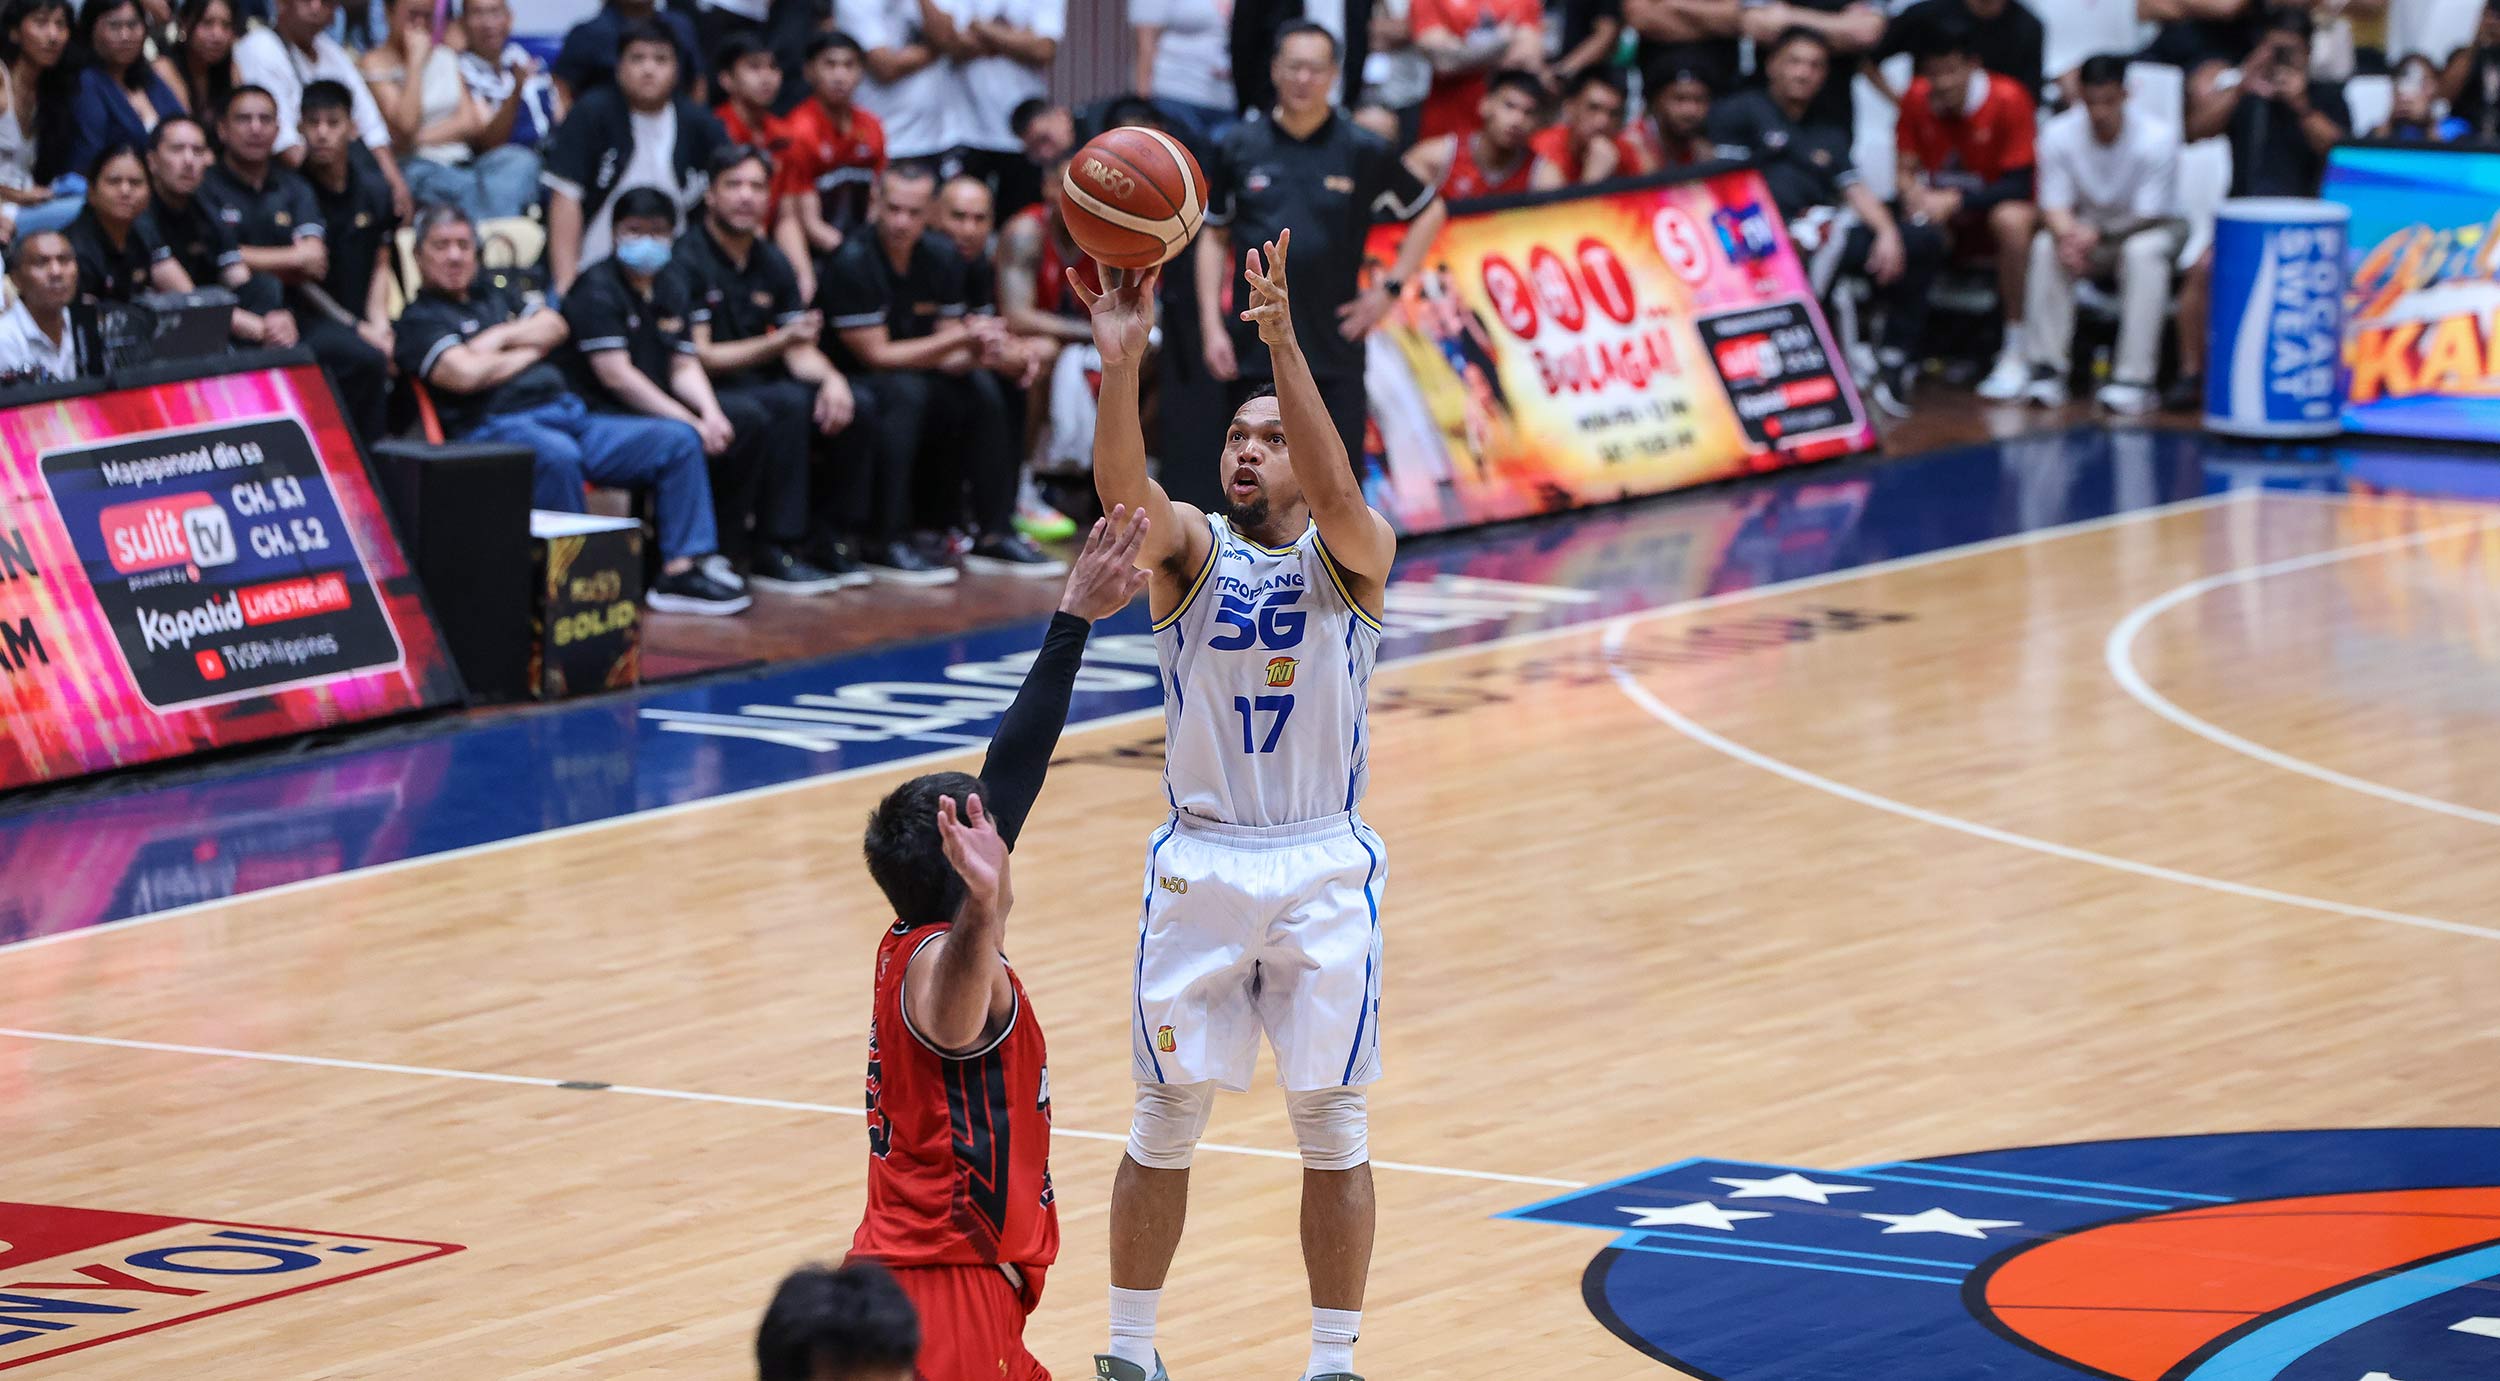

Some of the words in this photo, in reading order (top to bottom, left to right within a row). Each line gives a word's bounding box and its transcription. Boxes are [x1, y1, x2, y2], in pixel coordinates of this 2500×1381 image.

[212, 441, 243, 471] din
[240, 441, 265, 466] sa
[231, 480, 276, 517] CH.
[250, 523, 296, 560] CH.
[136, 589, 245, 653] Kapatid
[1208, 589, 1307, 651] 5G
[1264, 654, 1301, 688] TNT
[1234, 692, 1297, 755] 17
